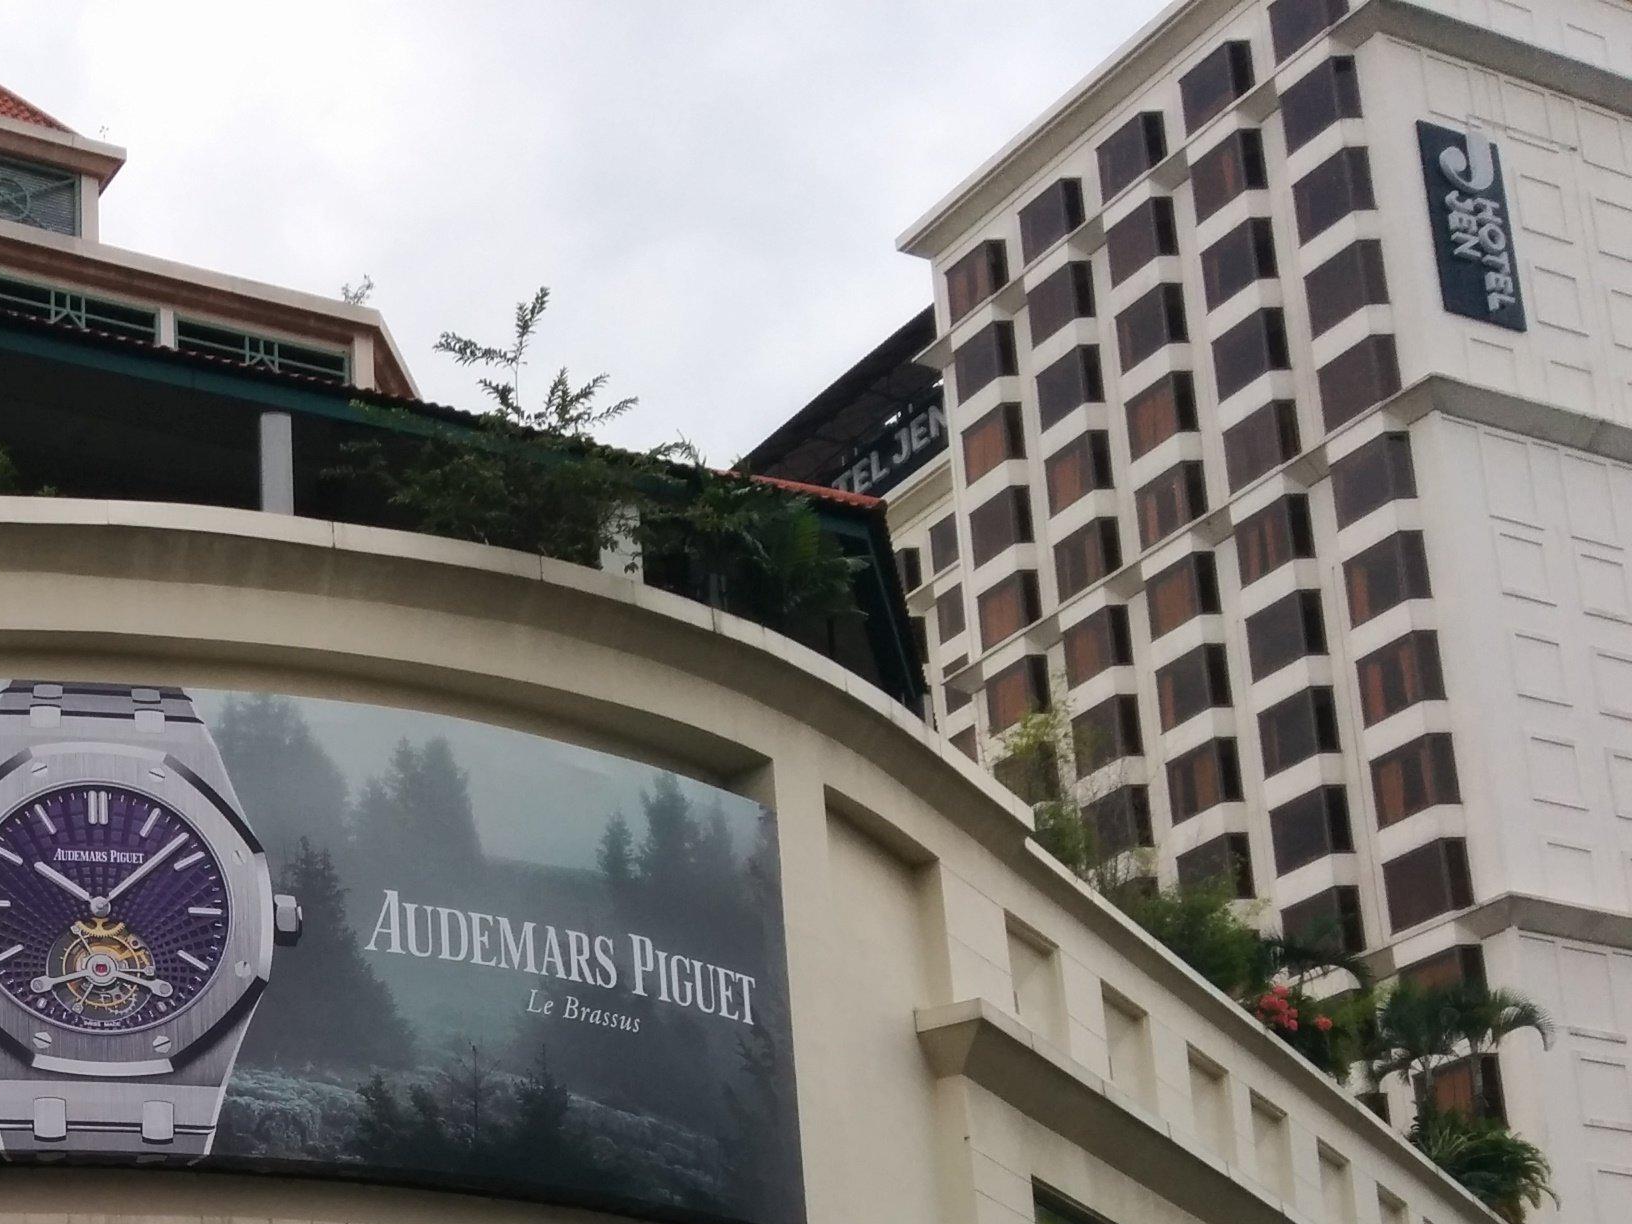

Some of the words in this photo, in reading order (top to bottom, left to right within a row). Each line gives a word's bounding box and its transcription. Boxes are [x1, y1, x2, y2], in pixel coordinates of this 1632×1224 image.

[1445, 190, 1483, 257] JEN
[1475, 197, 1516, 312] HOTEL
[832, 450, 891, 495] TEL
[53, 848, 107, 863] AUDEMARS
[110, 849, 144, 864] PIGUET
[364, 889, 618, 989] AUDEMARS
[628, 933, 756, 1026] PIGUET
[526, 989, 554, 1016] Le
[562, 996, 641, 1034] Brassus
